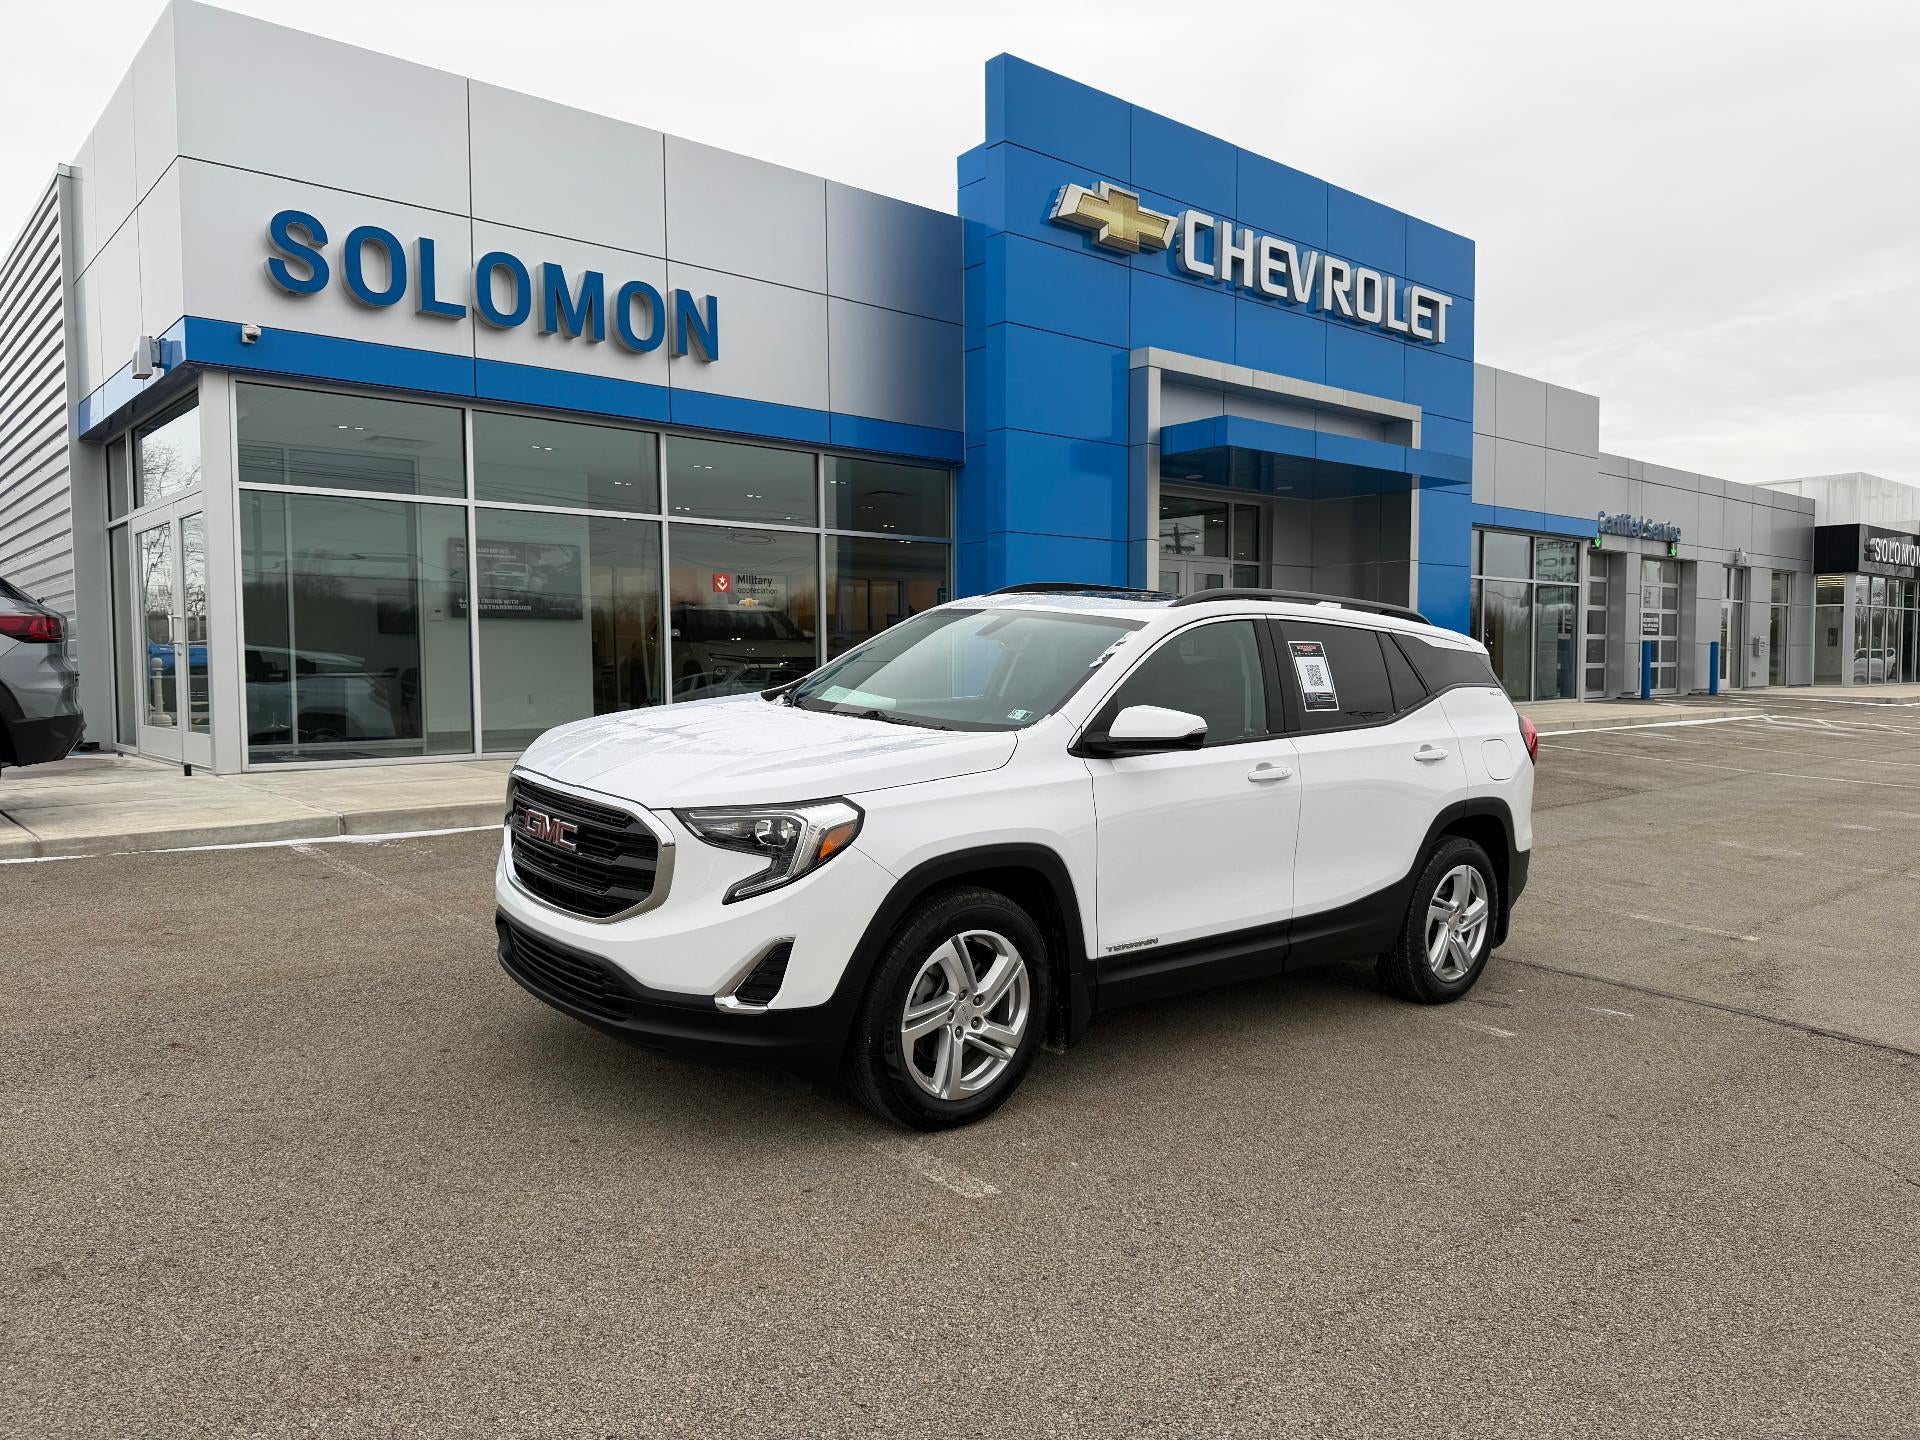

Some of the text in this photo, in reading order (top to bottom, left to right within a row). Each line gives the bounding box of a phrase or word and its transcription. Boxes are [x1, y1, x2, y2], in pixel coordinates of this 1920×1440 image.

[266, 209, 718, 362] SOLOMON
[1178, 209, 1453, 344] CHEVROLET
[737, 574, 773, 587] Military
[524, 809, 578, 851] GMC
[1106, 937, 1158, 952] TERRAIN
